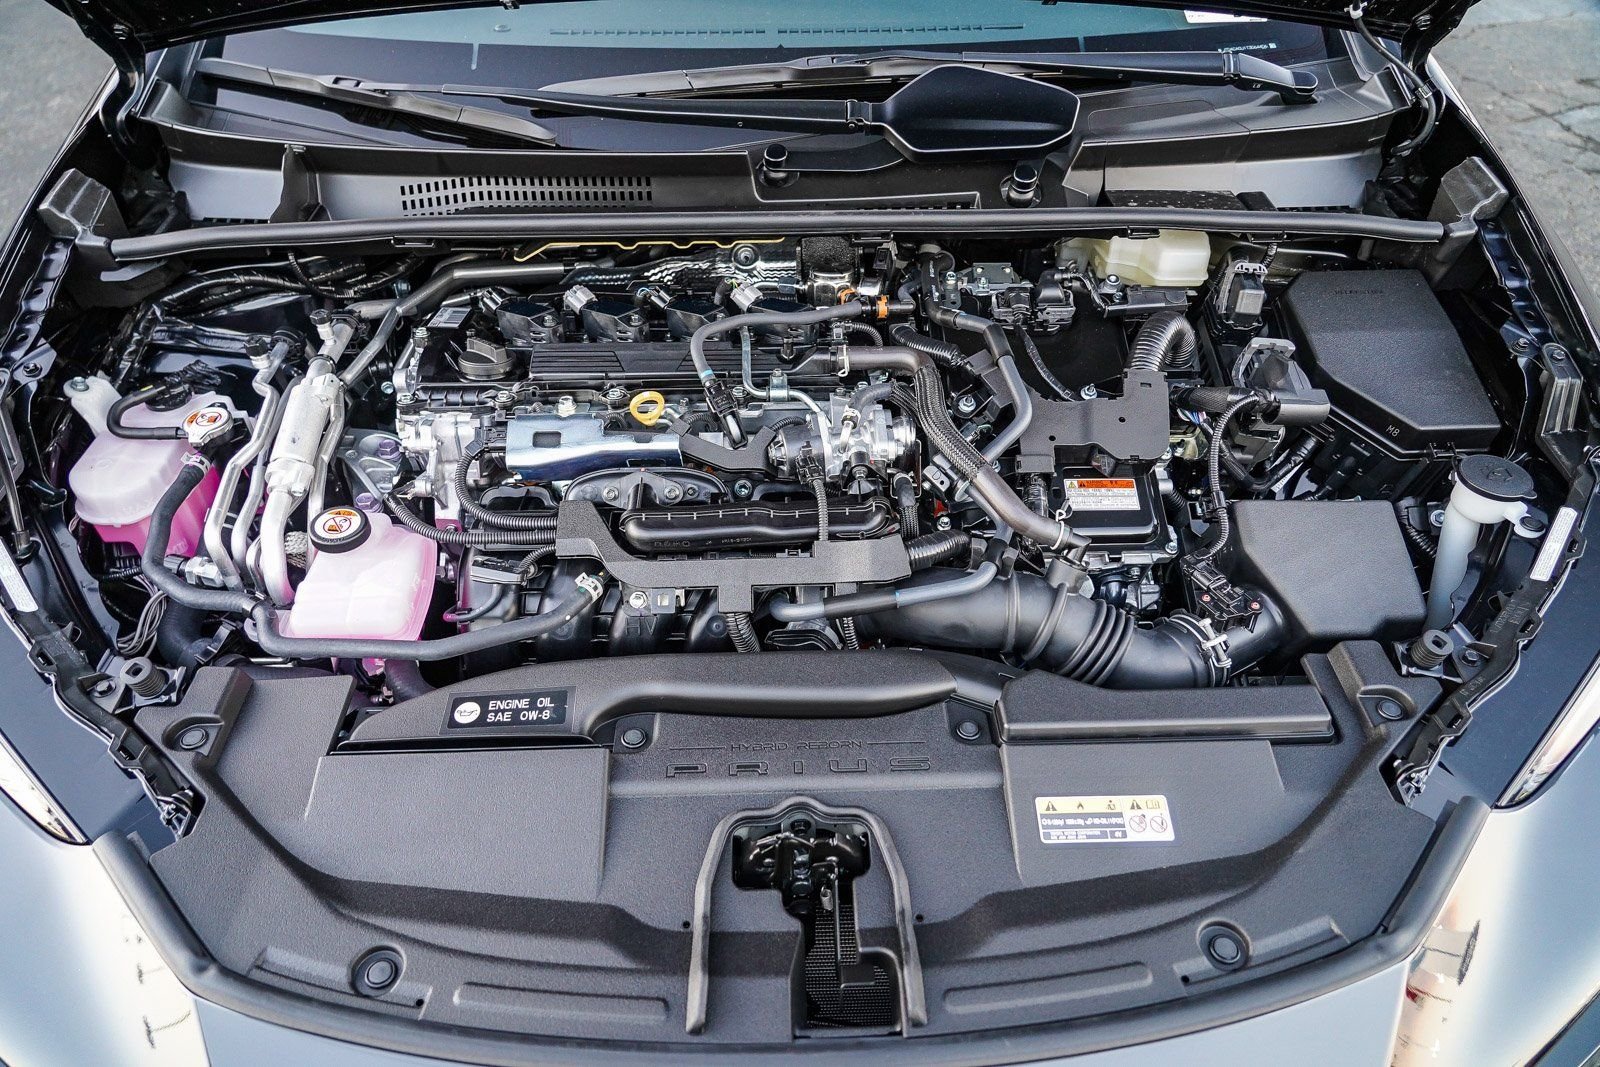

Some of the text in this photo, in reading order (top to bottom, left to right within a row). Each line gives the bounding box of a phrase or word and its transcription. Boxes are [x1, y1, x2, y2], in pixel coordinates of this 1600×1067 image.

[488, 697, 554, 710] ENGINE OIL
[486, 712, 512, 722] SAE
[730, 740, 862, 752] HYBRID REBORN
[665, 756, 931, 778] PRIUS
